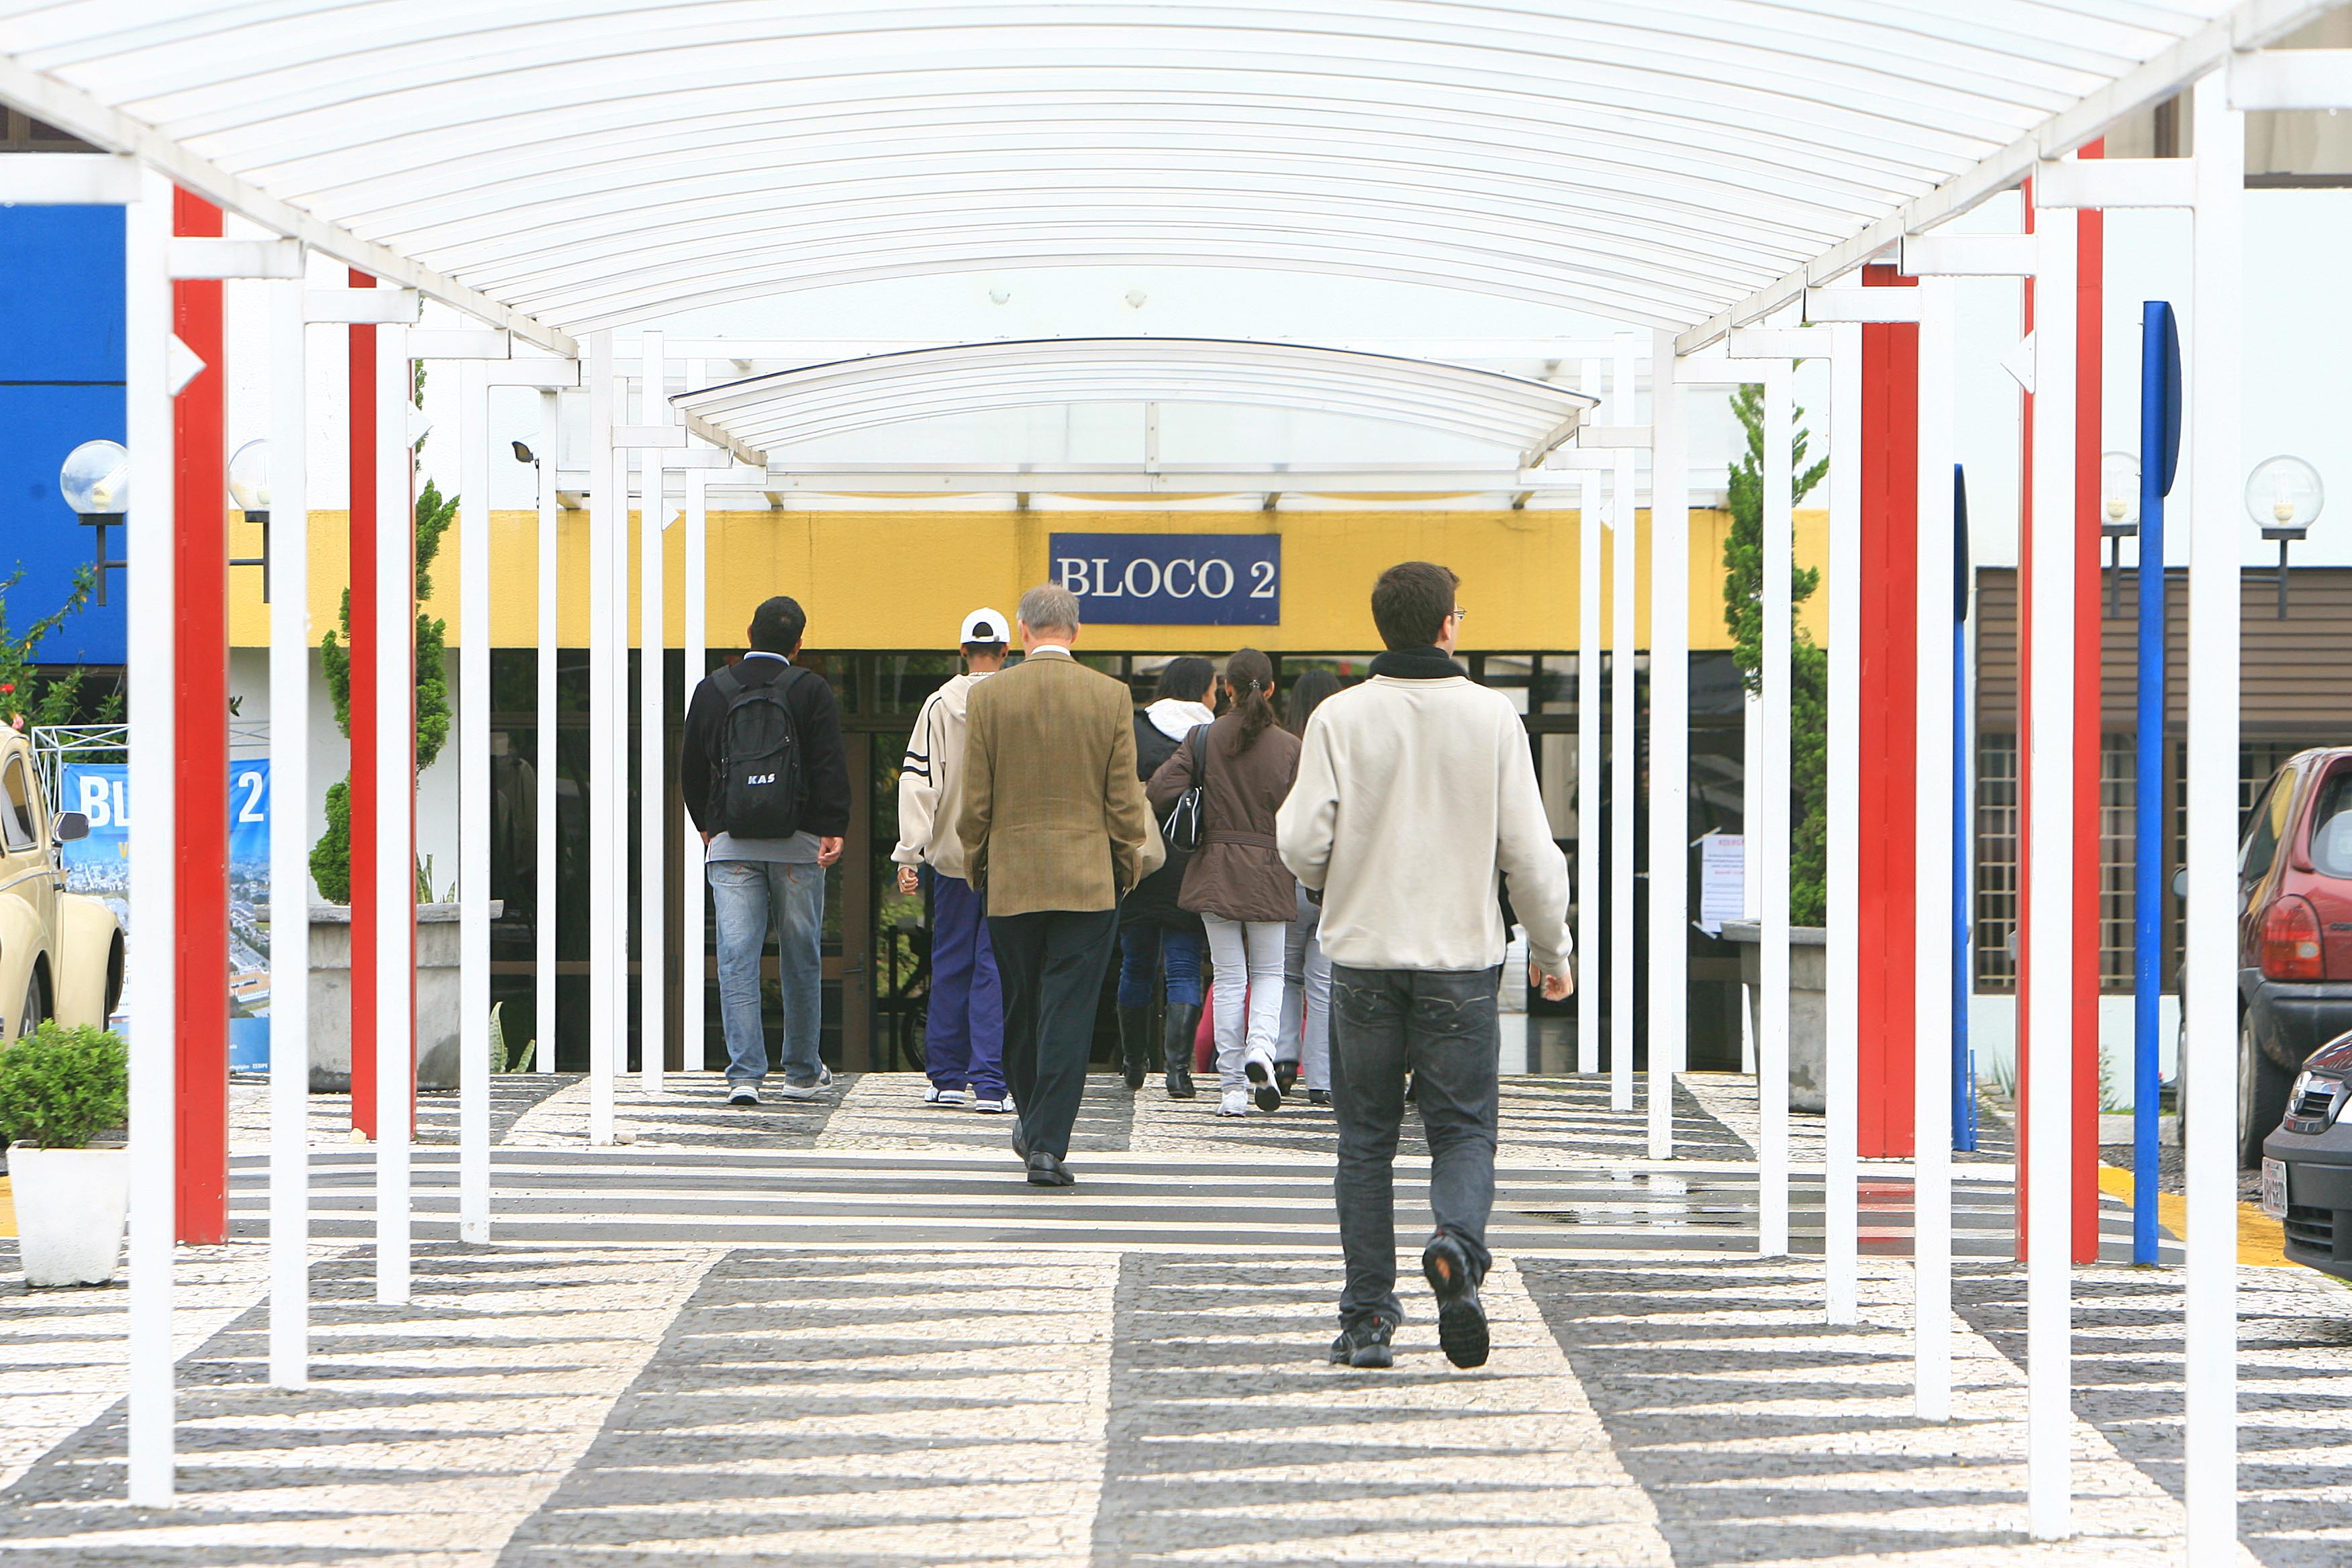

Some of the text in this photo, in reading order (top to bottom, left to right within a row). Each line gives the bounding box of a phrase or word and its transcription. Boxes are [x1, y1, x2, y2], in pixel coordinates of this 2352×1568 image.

[1057, 558, 1275, 599] BLOCO 2
[238, 771, 264, 823] 2
[748, 773, 775, 785] KAS
